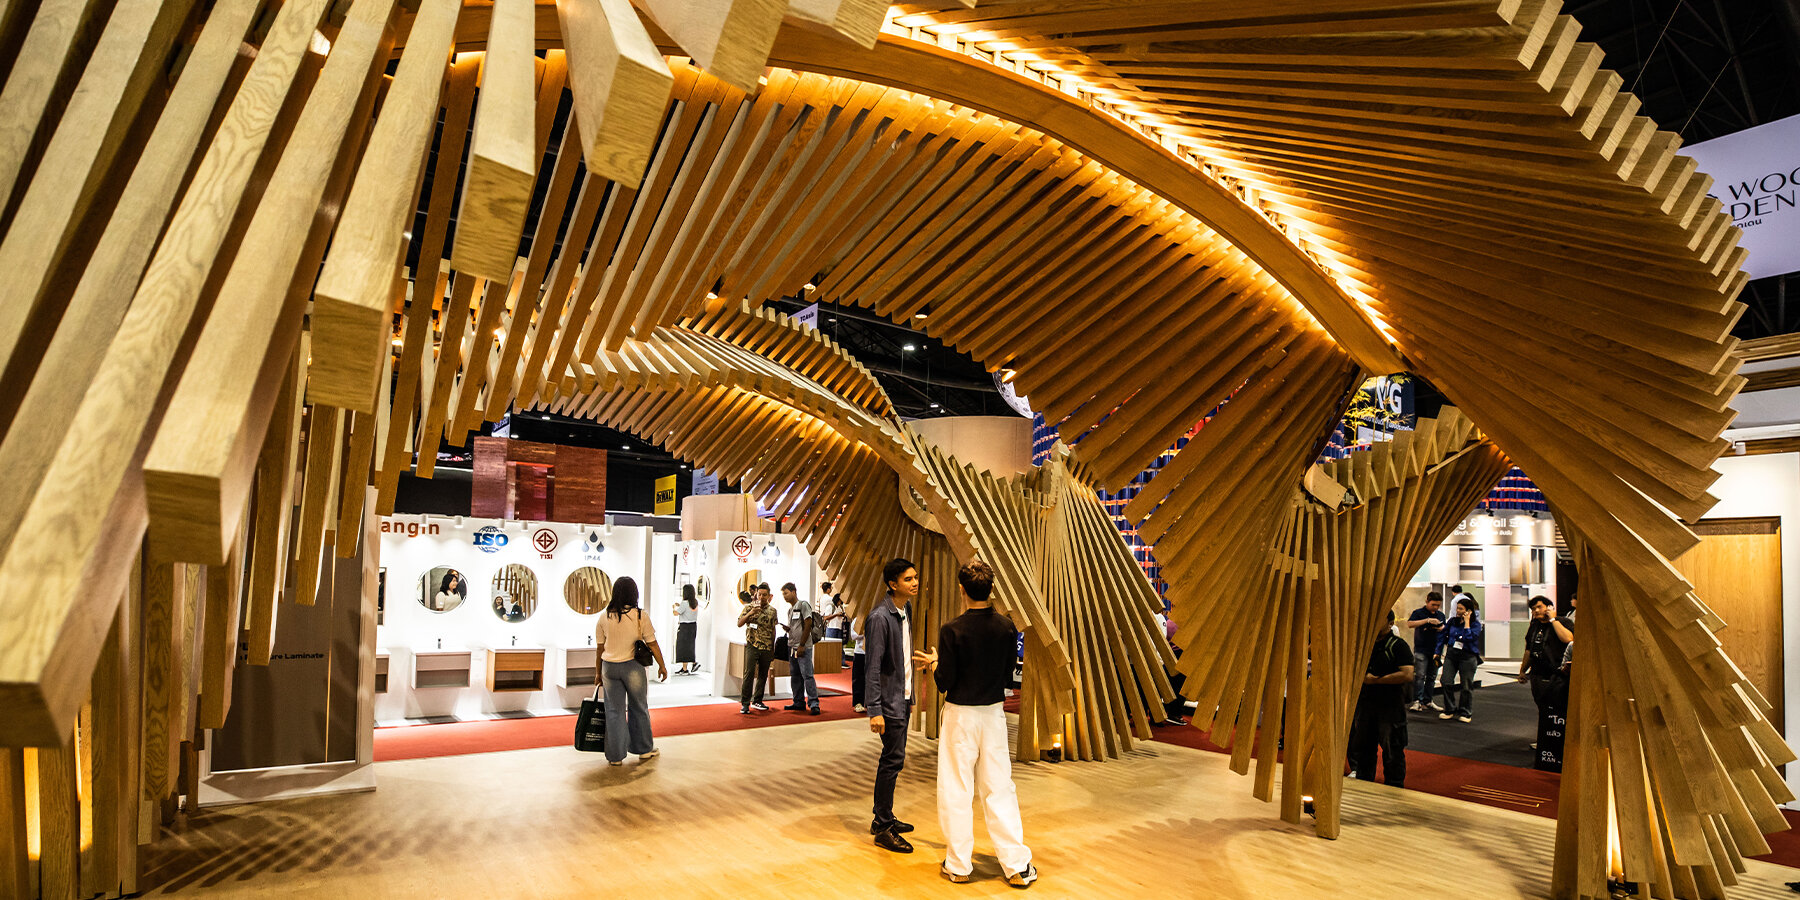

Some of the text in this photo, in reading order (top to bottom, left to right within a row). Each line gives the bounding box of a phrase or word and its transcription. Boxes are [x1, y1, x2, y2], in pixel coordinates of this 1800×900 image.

[1730, 190, 1795, 221] DEN
[380, 521, 440, 538] angin
[473, 532, 509, 548] ISO
[284, 652, 324, 660] Laminate
